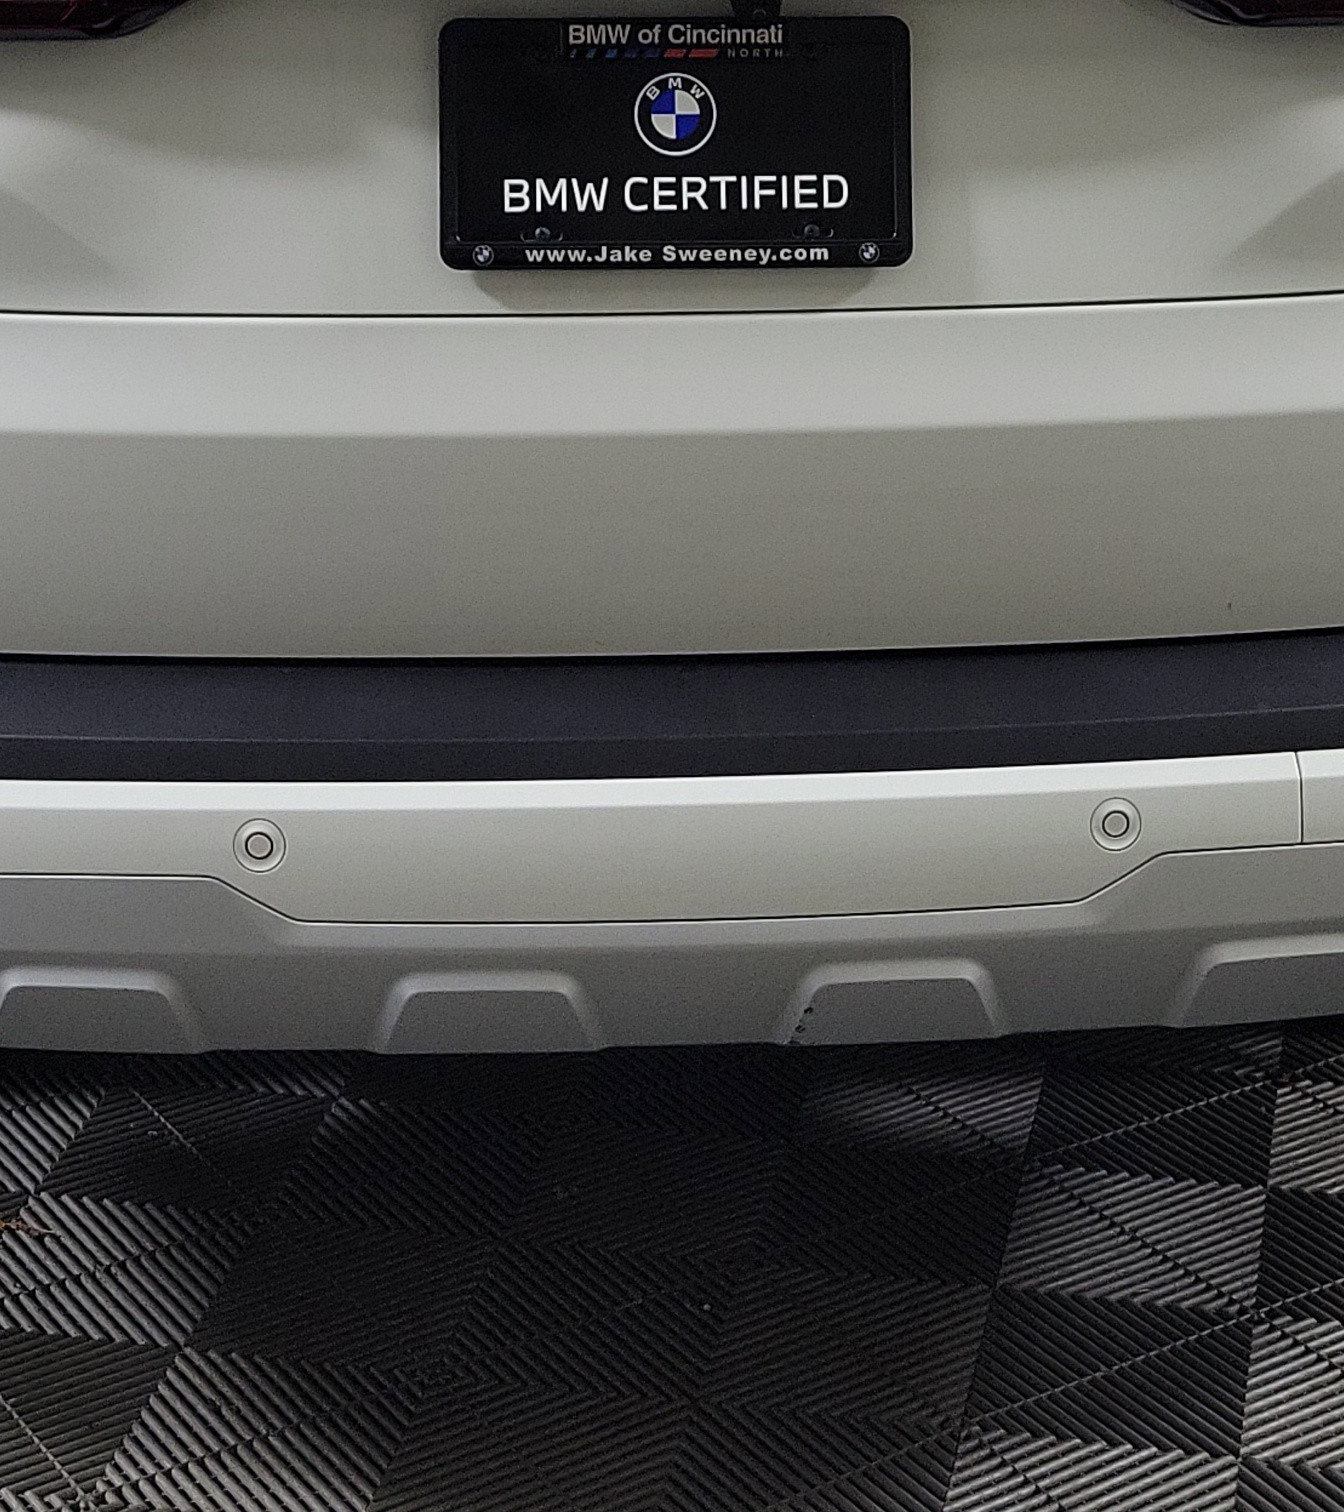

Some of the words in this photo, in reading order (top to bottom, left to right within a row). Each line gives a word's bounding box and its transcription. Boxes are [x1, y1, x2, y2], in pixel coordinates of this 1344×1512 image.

[568, 24, 631, 44] BMW
[638, 24, 661, 44] of
[668, 24, 783, 44] Cincinnati
[727, 48, 783, 58] NORTH
[646, 78, 706, 101] BMW
[504, 177, 608, 213] BMW
[624, 174, 849, 211] CERTIFIED
[525, 245, 652, 264] www.Jake
[662, 245, 830, 268] Sweeney.com
